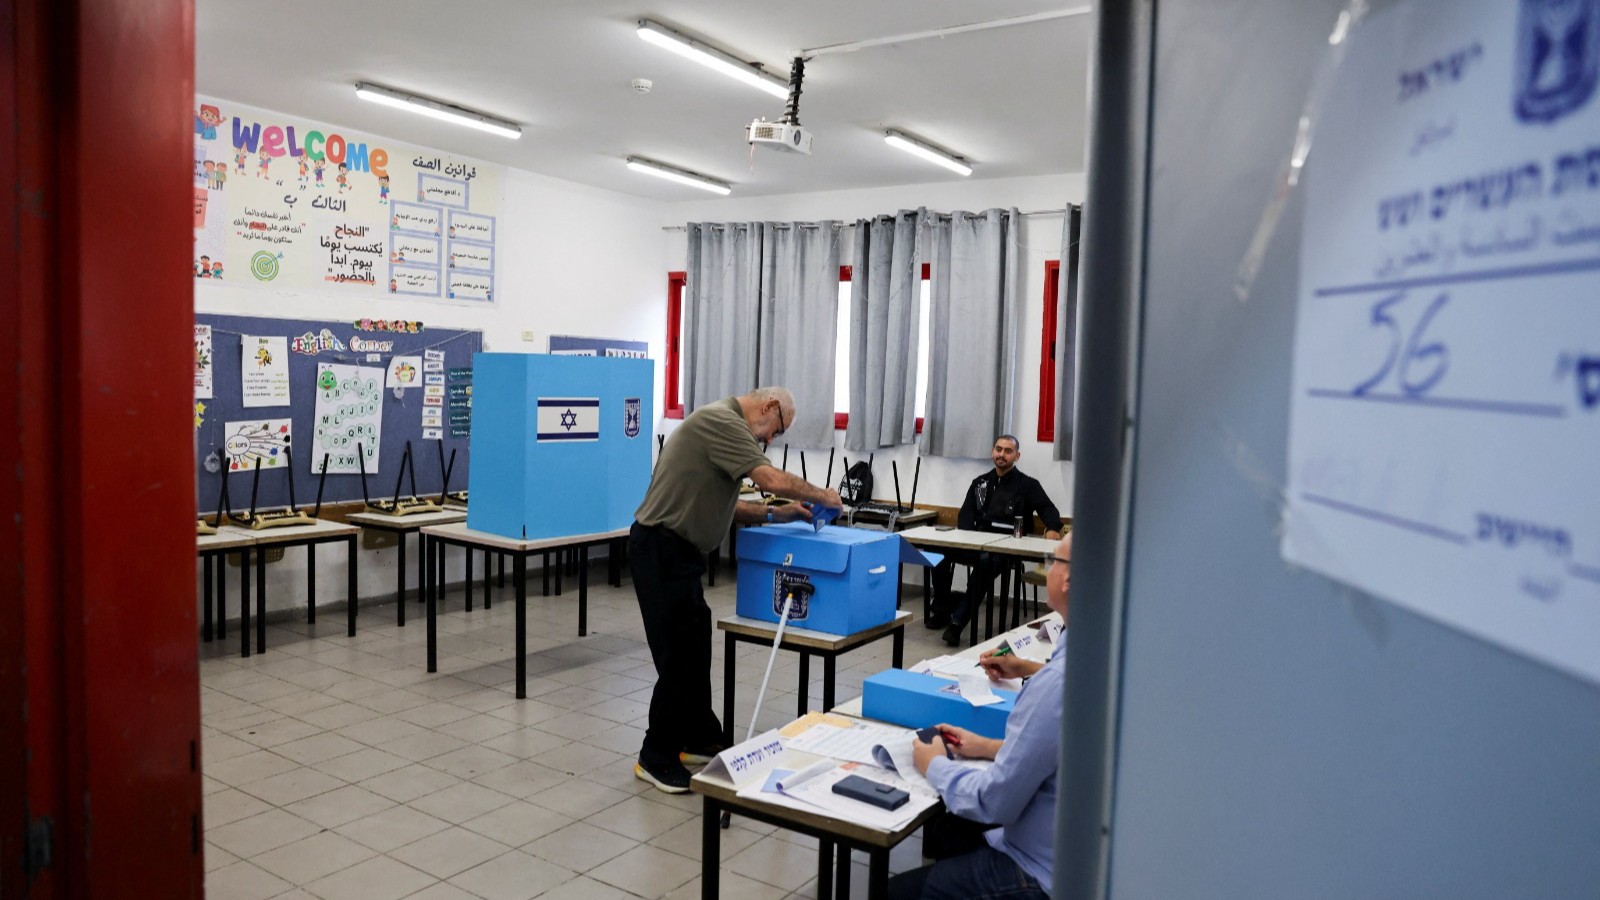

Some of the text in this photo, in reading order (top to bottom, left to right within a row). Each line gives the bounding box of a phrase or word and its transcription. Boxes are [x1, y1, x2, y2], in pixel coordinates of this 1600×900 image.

[412, 156, 477, 181] قوانين الصف
[292, 334, 393, 355] English Corner
[1353, 291, 1450, 398] 56
[322, 416, 329, 424] M
[357, 426, 363, 434] R
[371, 437, 376, 445] T
[338, 457, 344, 465] X
[730, 755, 748, 772] קלפי
